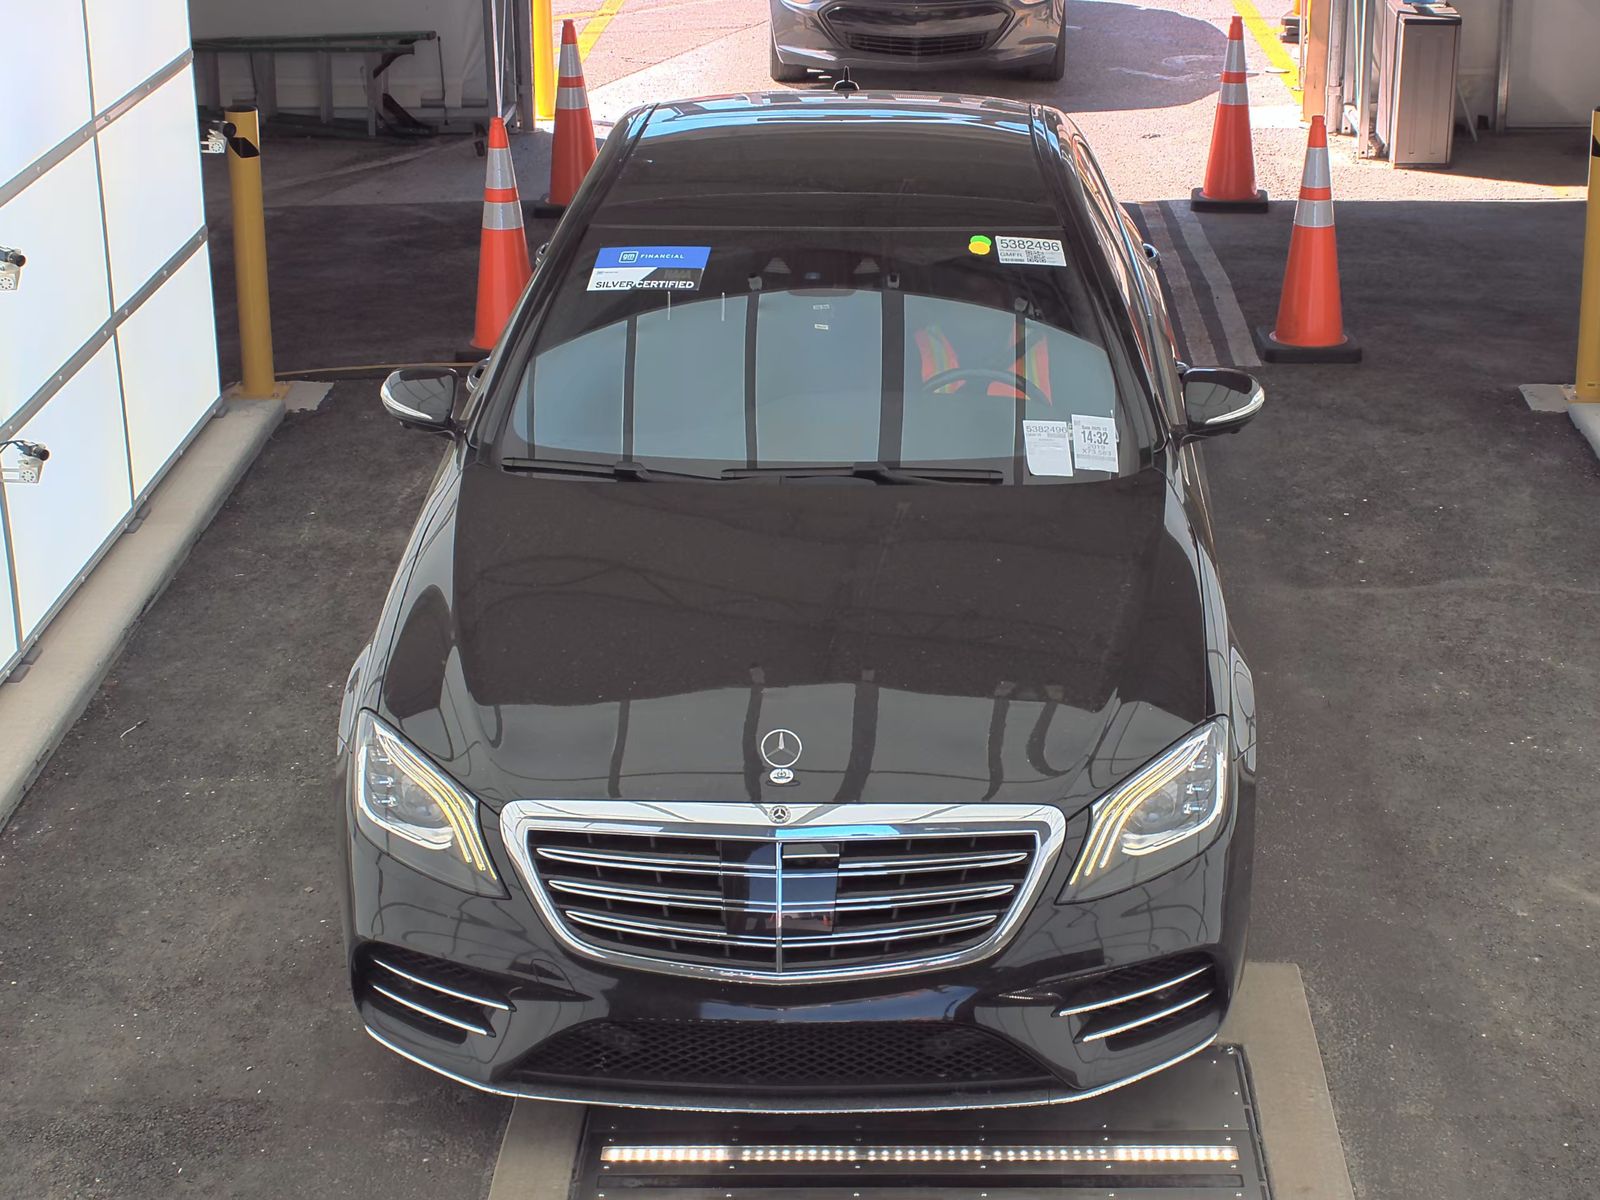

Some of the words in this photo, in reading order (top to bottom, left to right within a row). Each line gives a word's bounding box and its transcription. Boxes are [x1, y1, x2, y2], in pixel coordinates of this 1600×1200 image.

[1000, 239, 1060, 252] 5382496
[636, 280, 695, 289] CERTIFIED
[1081, 430, 1109, 445] 14:32
